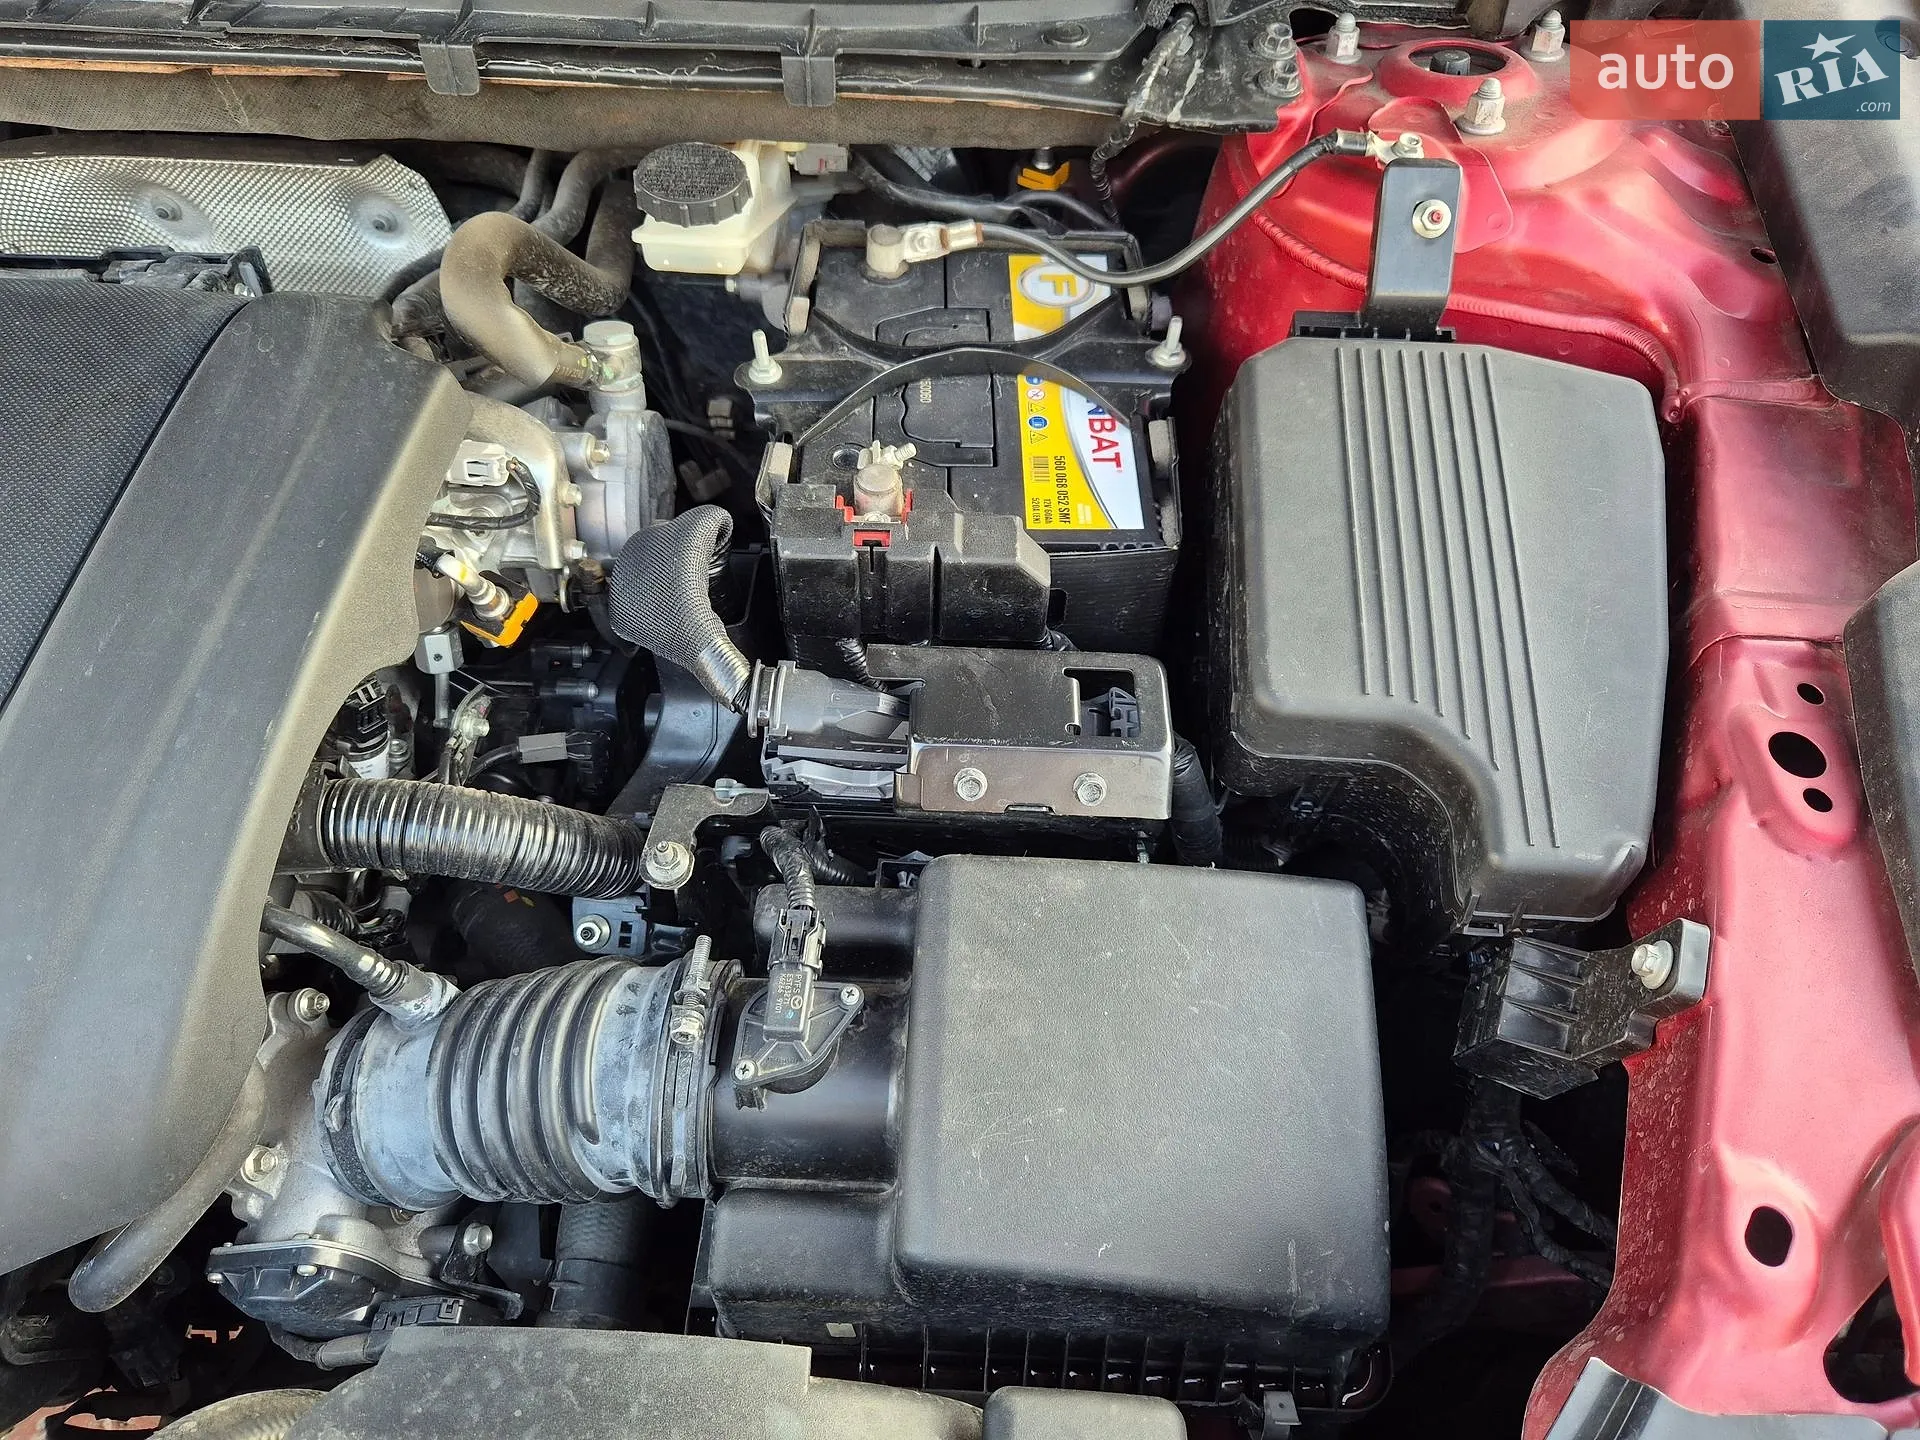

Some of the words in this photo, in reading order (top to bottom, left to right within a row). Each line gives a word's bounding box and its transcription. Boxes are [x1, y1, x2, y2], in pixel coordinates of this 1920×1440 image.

[1040, 273, 1078, 298] F
[1053, 455, 1067, 471] 560
[1055, 472, 1069, 489] 068
[1031, 497, 1041, 511] 520A
[1056, 490, 1070, 506] 052
[1058, 507, 1072, 525] SMF
